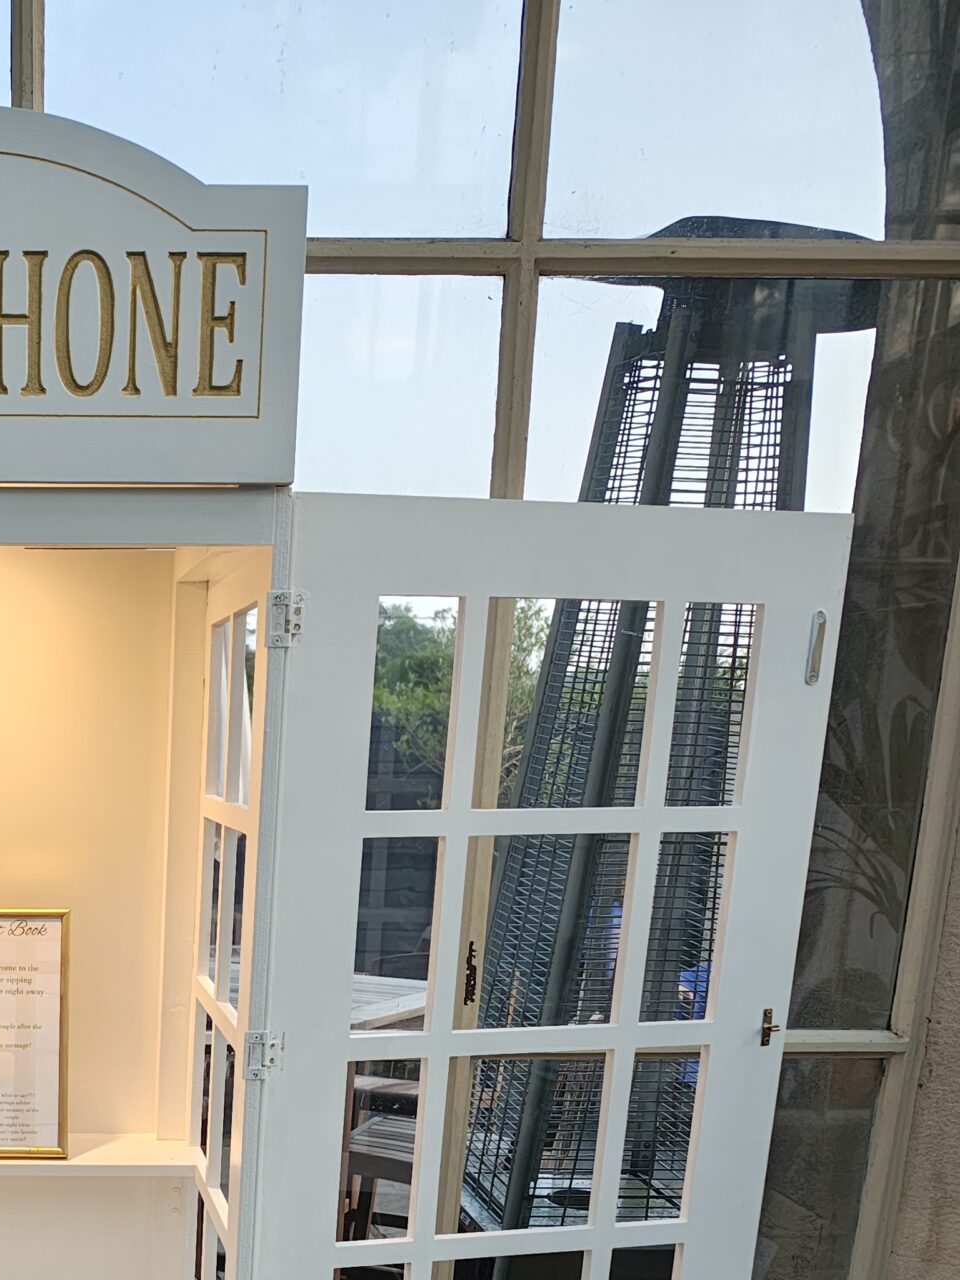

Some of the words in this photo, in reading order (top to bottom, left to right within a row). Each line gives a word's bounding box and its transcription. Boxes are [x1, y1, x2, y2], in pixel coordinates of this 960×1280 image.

[8, 919, 48, 937] Book
[28, 964, 40, 972] the
[6, 977, 33, 985] sipping
[5, 987, 24, 996] night
